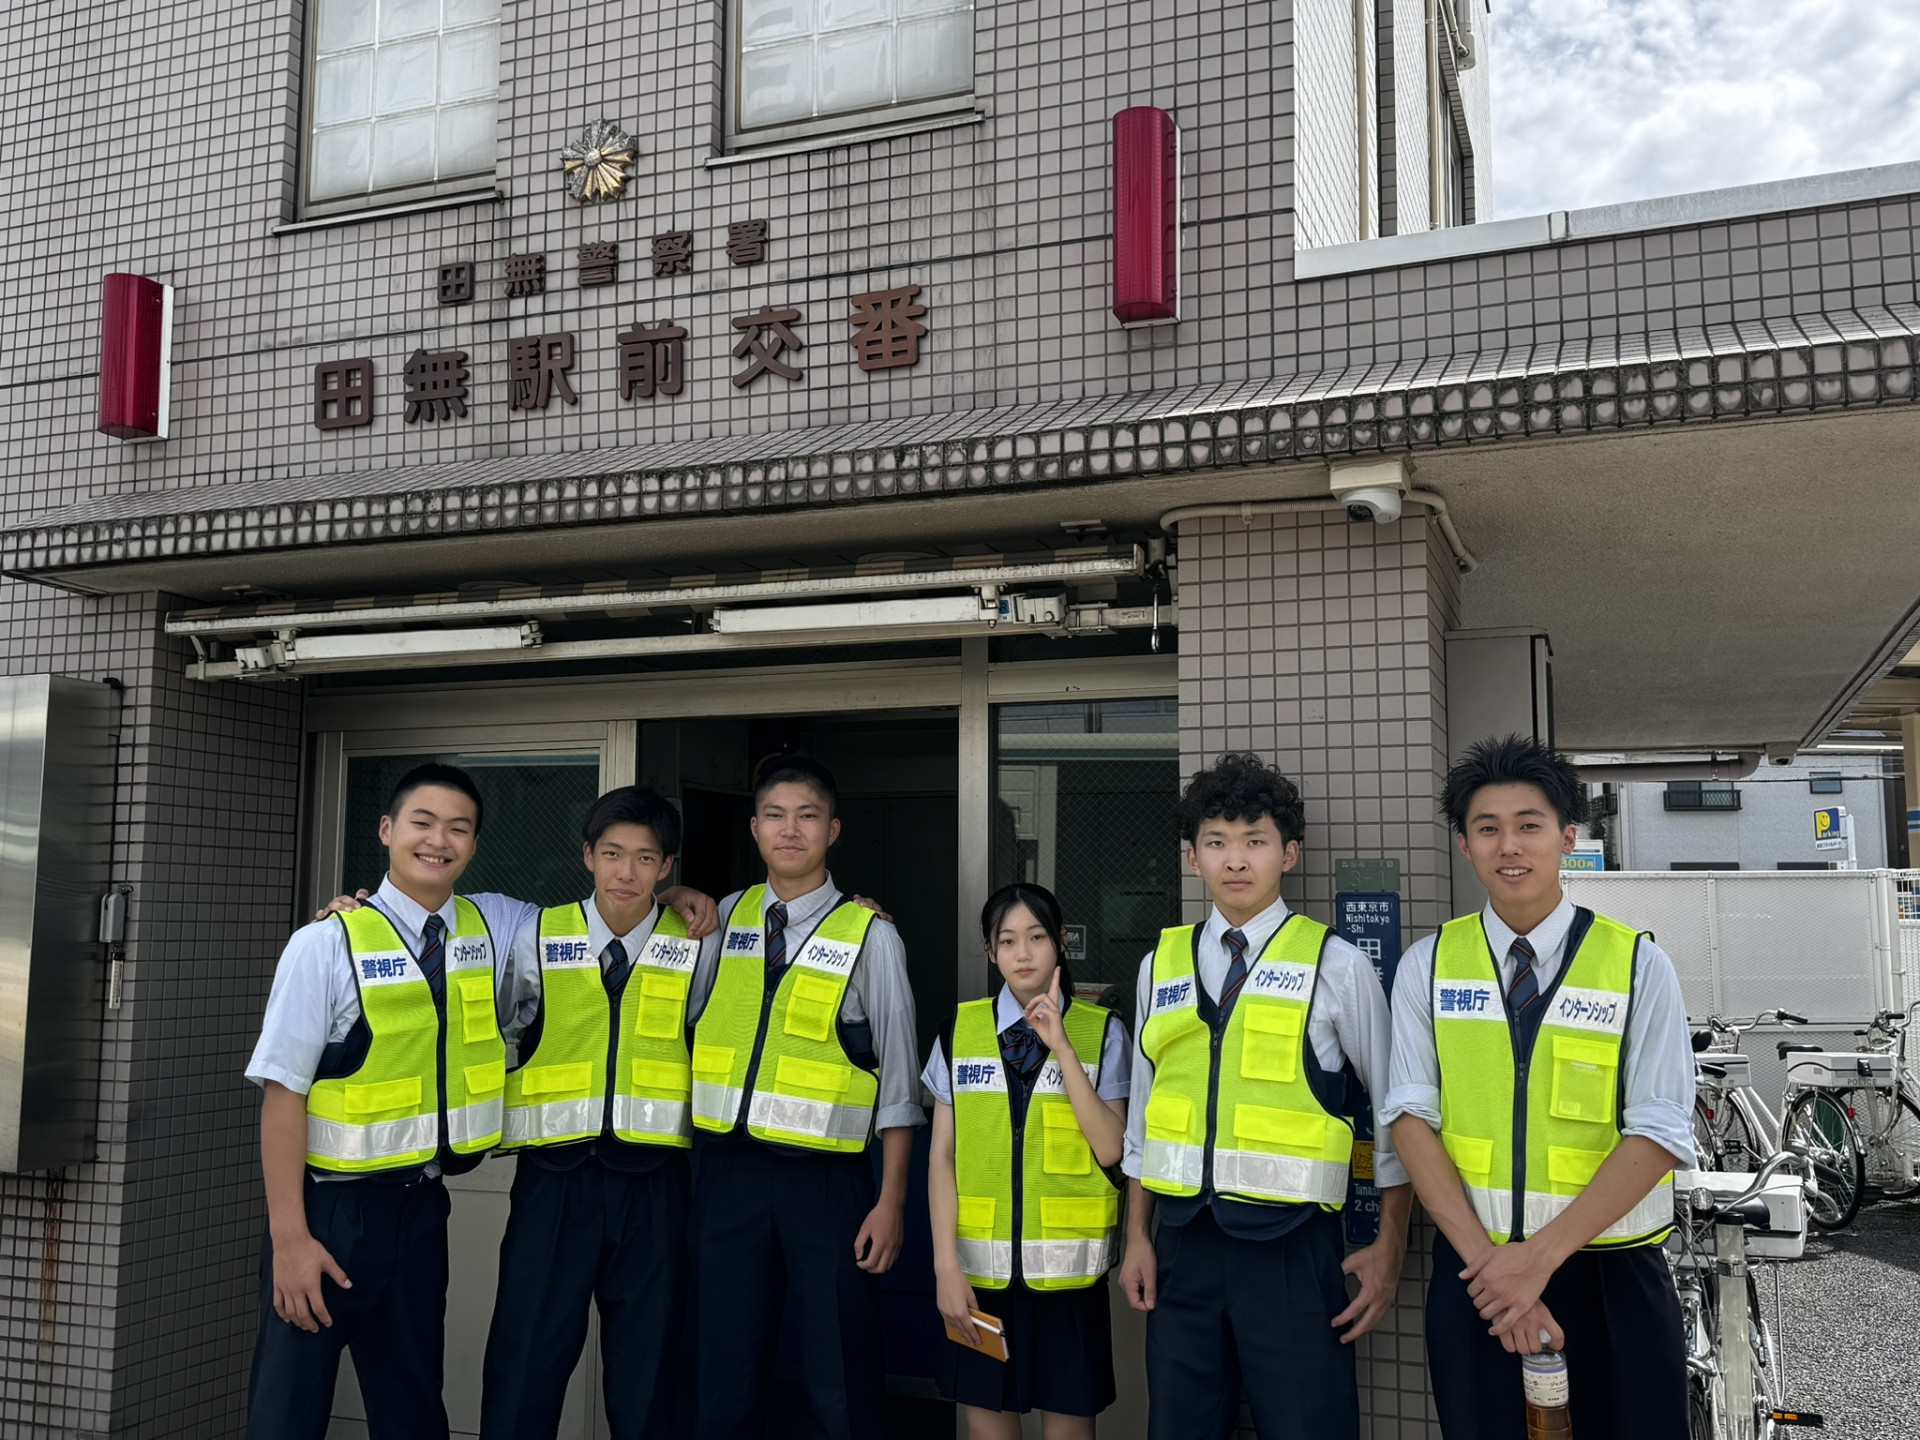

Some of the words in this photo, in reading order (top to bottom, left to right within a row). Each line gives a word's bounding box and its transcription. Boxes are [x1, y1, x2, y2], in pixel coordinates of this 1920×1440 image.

[438, 218, 768, 306] 田無警察署
[314, 284, 929, 430] 田無駅前交番
[1346, 901, 1389, 912] 西東京市
[1346, 914, 1390, 926] Nishitokyo
[1346, 924, 1365, 934] -Shi
[545, 941, 588, 963] 警視庁
[726, 931, 761, 951] 警視庁
[453, 943, 487, 962] インターンシップ
[649, 941, 691, 965] インターンシップ
[807, 944, 851, 968] インターンシップ
[361, 956, 407, 979] 警視庁
[1254, 968, 1307, 992] インターンシップ
[1156, 983, 1192, 1010] 警視庁
[1439, 987, 1490, 1012] 警視庁
[1559, 996, 1618, 1026] インターンシップ
[957, 1064, 996, 1086] 警視庁
[1046, 1067, 1064, 1086] インタ
[1847, 1078, 1878, 1086] POLICE
[1354, 1199, 1362, 1212] 2
[1365, 1200, 1382, 1213] chi
